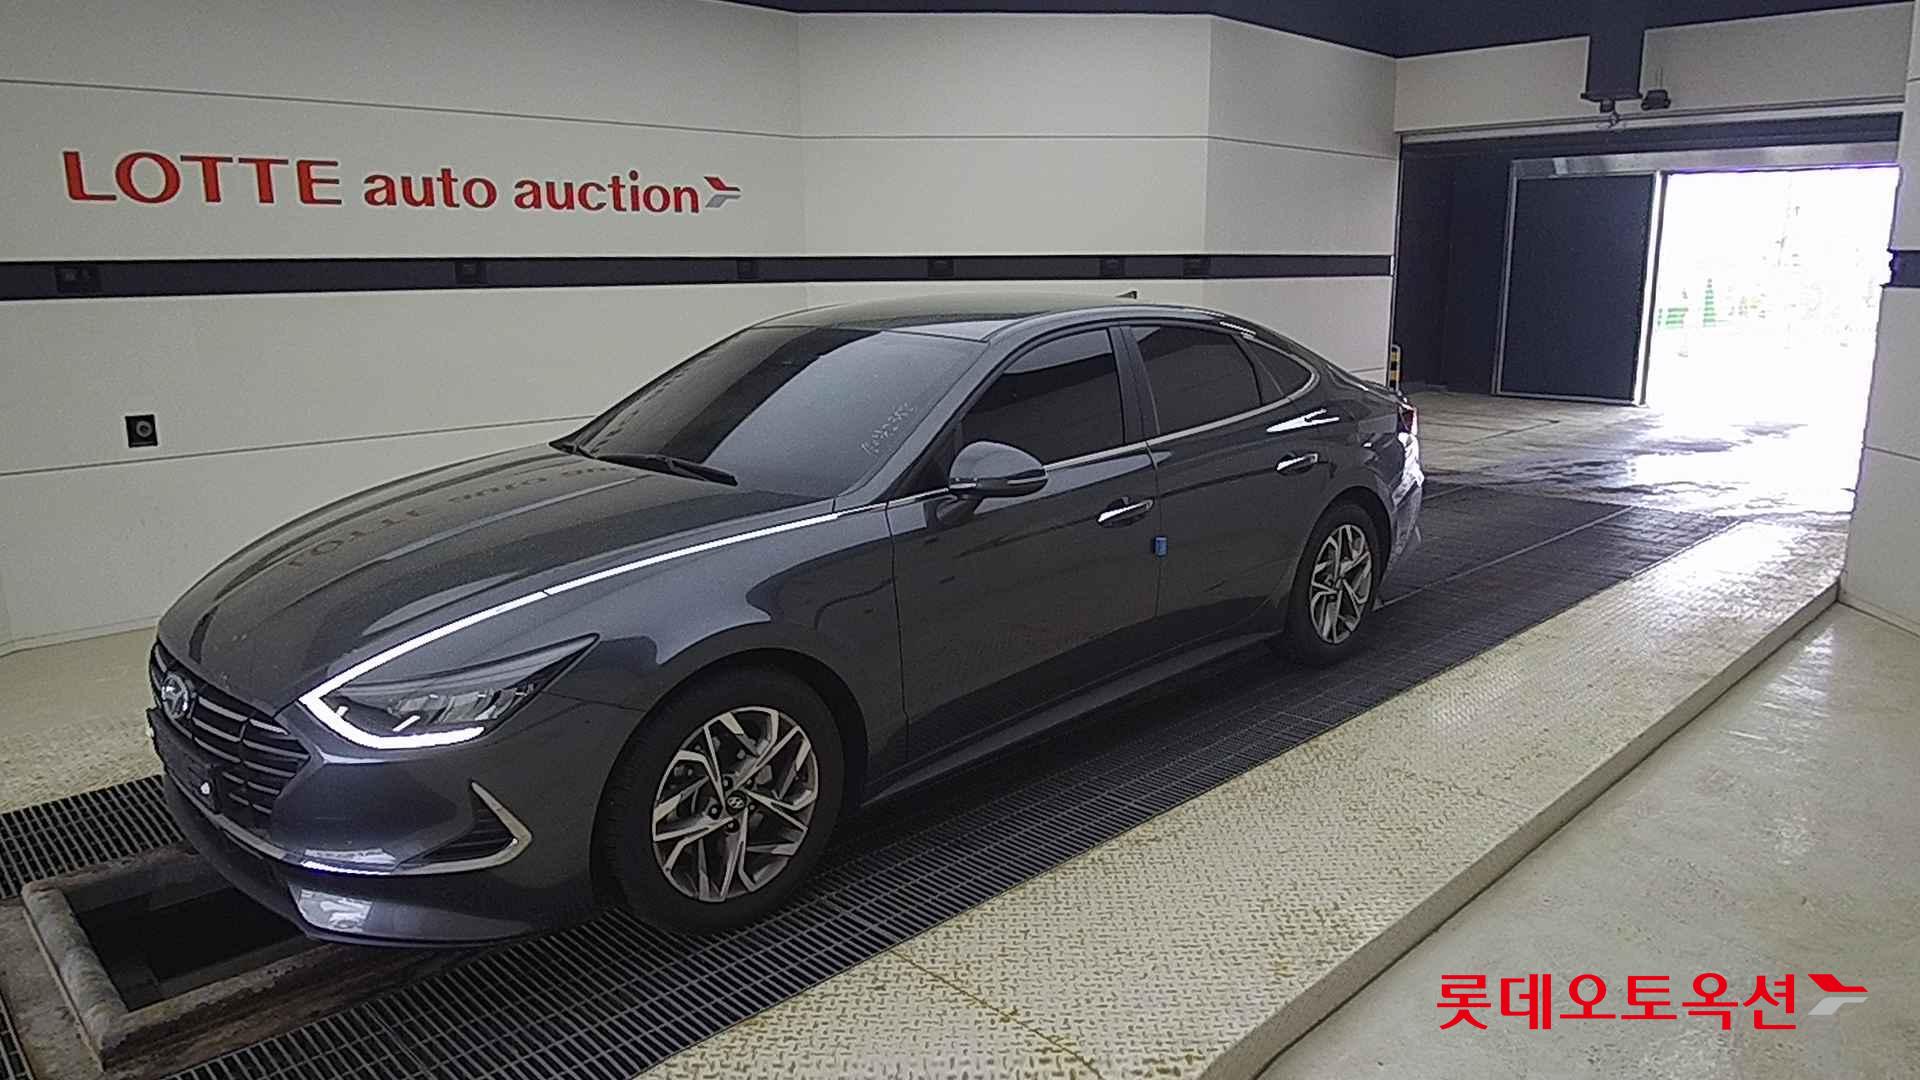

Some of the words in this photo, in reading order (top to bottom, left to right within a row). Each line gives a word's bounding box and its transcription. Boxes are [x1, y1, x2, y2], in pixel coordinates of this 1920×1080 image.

[62, 150, 342, 205] LOTTE
[363, 167, 498, 209] auto
[513, 168, 700, 212] auction
